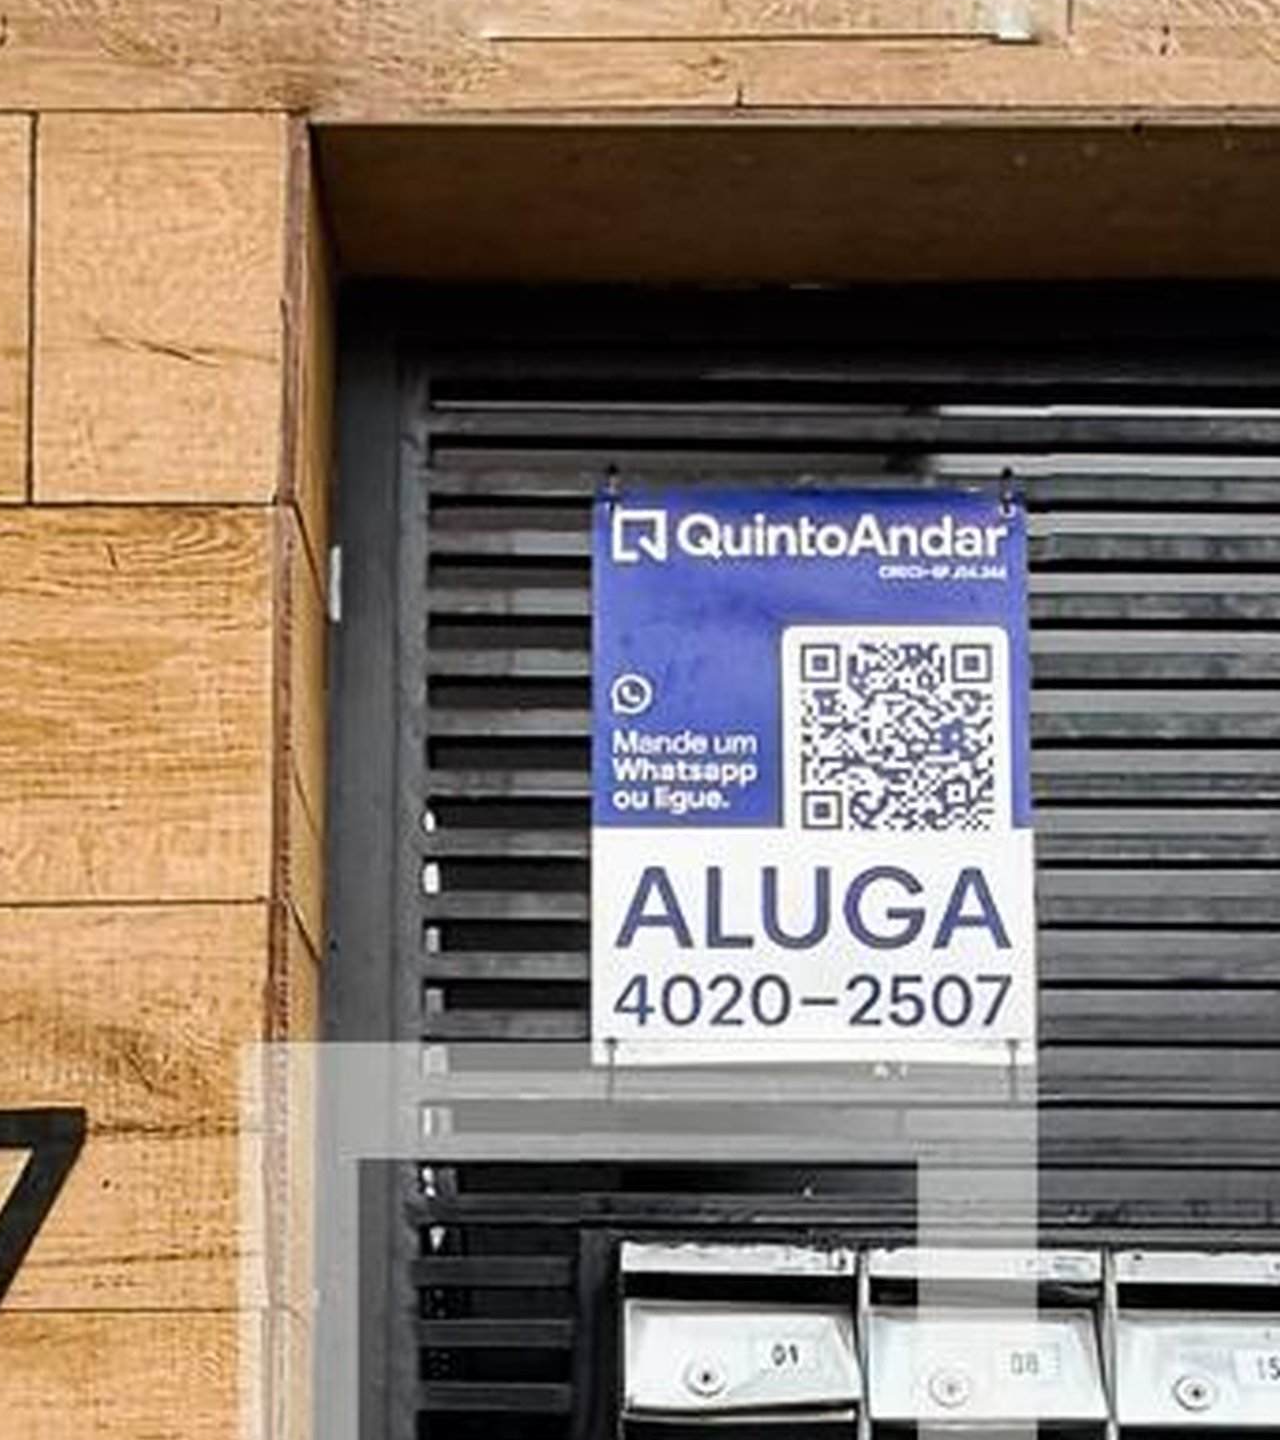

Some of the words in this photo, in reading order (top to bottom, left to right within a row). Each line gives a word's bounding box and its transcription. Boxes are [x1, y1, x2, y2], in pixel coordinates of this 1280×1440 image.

[677, 511, 1007, 560] QuintoAndar
[613, 731, 708, 755] Mande
[714, 736, 758, 755] um
[613, 760, 758, 786] Whatsapp
[613, 790, 649, 810] ou
[654, 787, 730, 815] ligue.
[615, 864, 1012, 950] ALUGA
[614, 974, 1012, 1027] 4020-2507
[771, 1343, 799, 1367] 01
